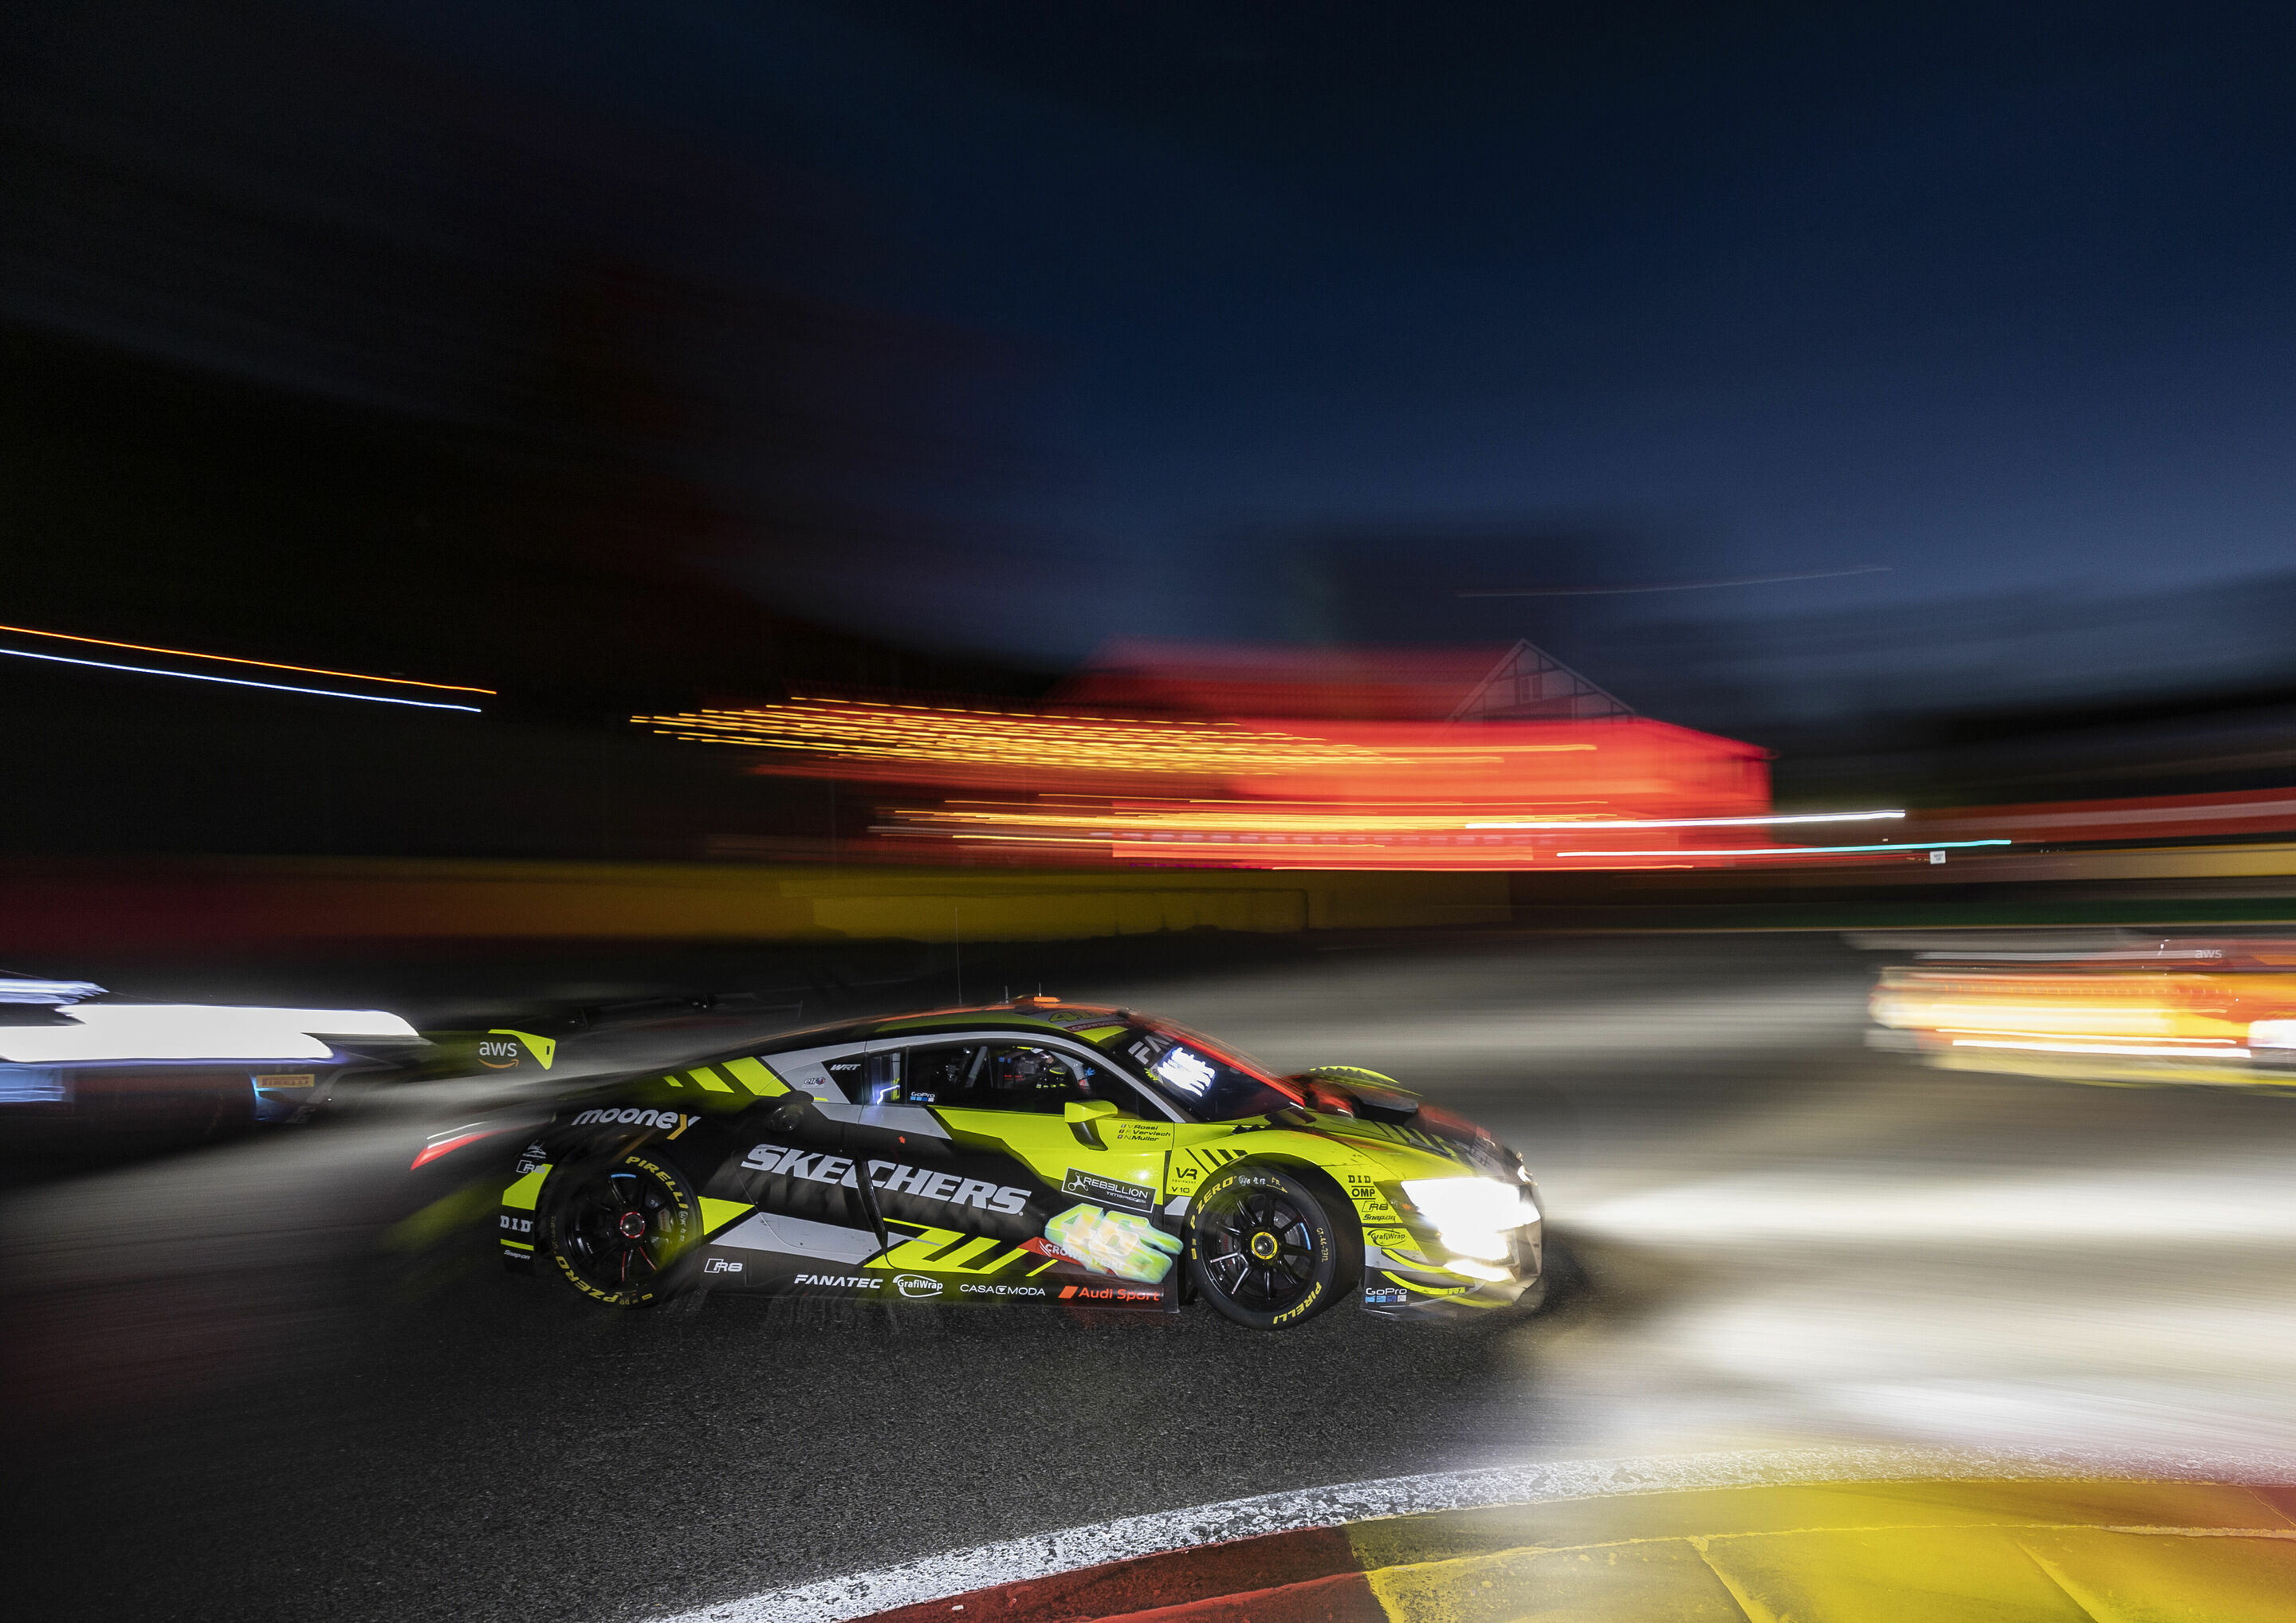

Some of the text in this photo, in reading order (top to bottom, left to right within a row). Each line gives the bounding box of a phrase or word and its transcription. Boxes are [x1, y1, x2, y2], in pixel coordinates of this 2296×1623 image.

[2195, 949, 2222, 959] aws
[479, 1041, 517, 1057] aws
[571, 1108, 702, 1140] mooney
[625, 1156, 690, 1209] PIRELLI
[741, 1143, 1032, 1215] SKECHERS
[1083, 1177, 1148, 1199] REBELLION
[1351, 1188, 1376, 1197] OMP
[1366, 1202, 1389, 1211] R8
[710, 1260, 743, 1273] R8
[794, 1274, 883, 1290] FANATEC
[897, 1279, 944, 1291] GrafiWrap
[1078, 1287, 1161, 1302] Audi Sport
[1273, 1281, 1323, 1325] PIRELLI
